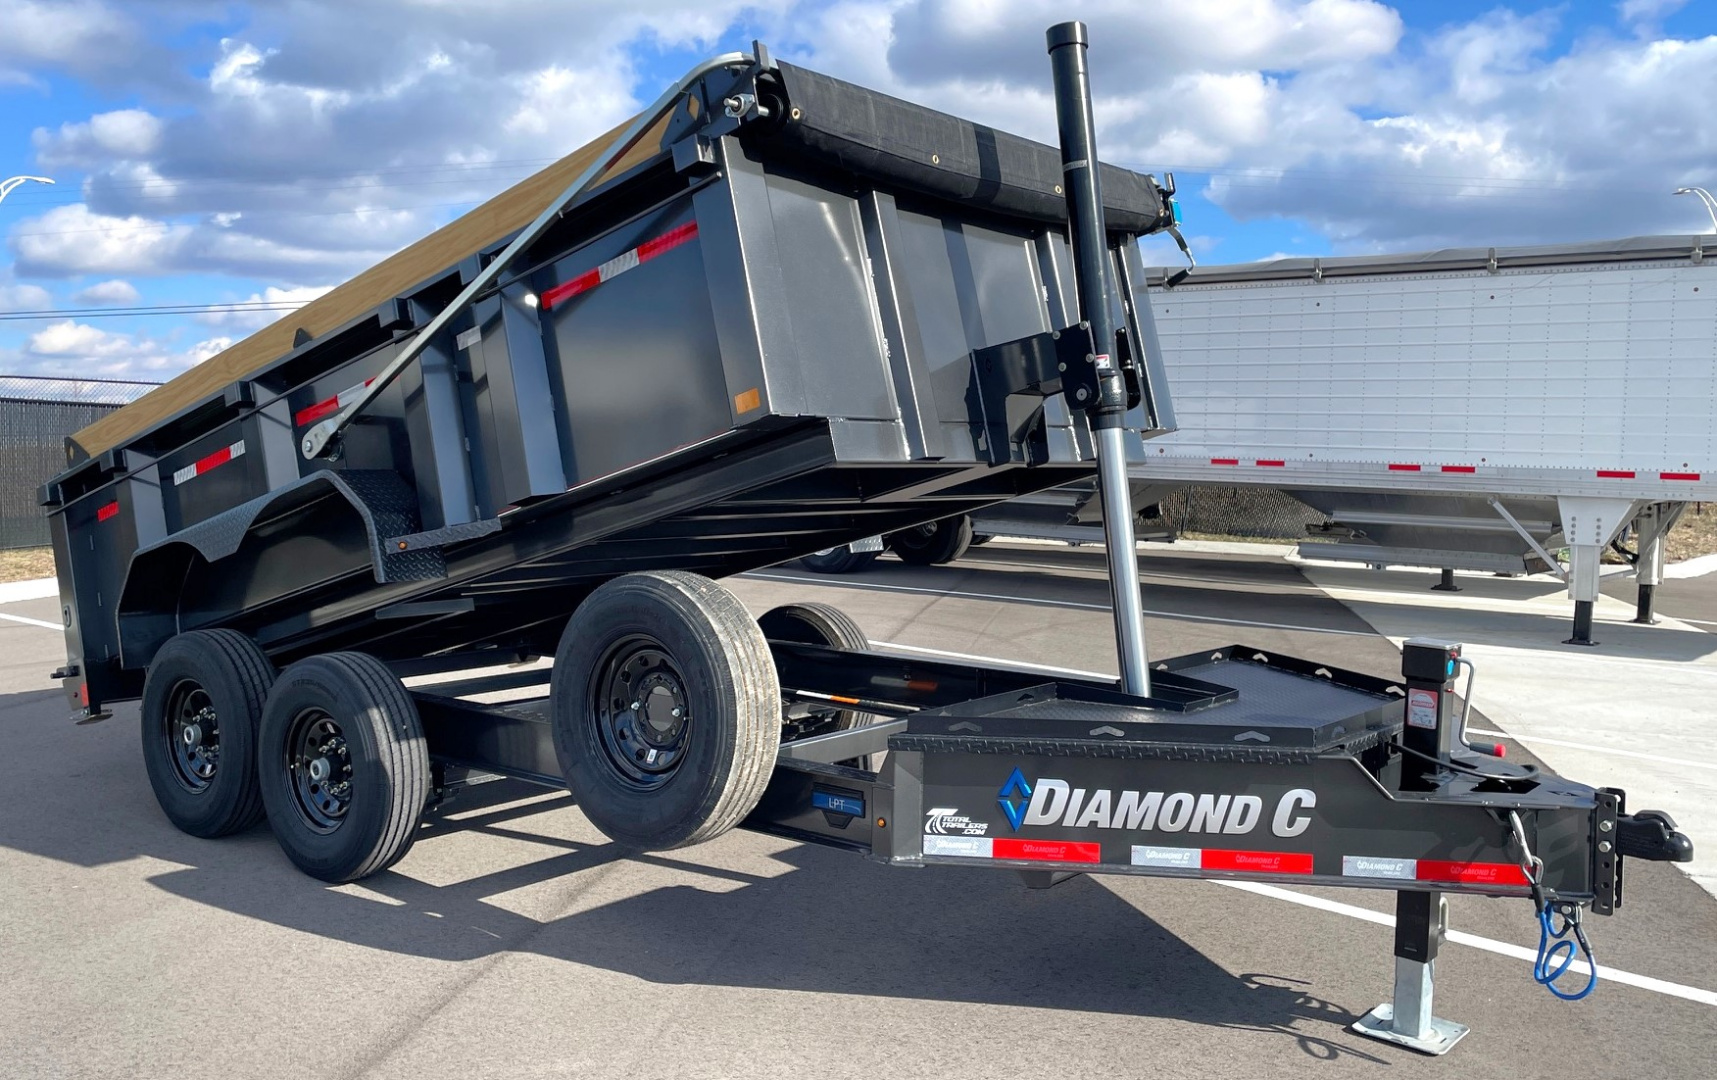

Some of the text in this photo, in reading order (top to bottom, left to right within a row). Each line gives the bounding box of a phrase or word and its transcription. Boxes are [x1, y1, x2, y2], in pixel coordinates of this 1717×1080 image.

[1023, 778, 1317, 838] DIAMOND C
[941, 822, 989, 830] TRAILERS
[962, 828, 986, 836] .COM
[1027, 845, 1066, 854] DIAMOND C
[1150, 851, 1190, 860] DIAMOND C
[1240, 855, 1273, 864] DIAMOND
[1361, 860, 1403, 871] DIAMOND C
[1456, 867, 1497, 876] DIAMOND C
